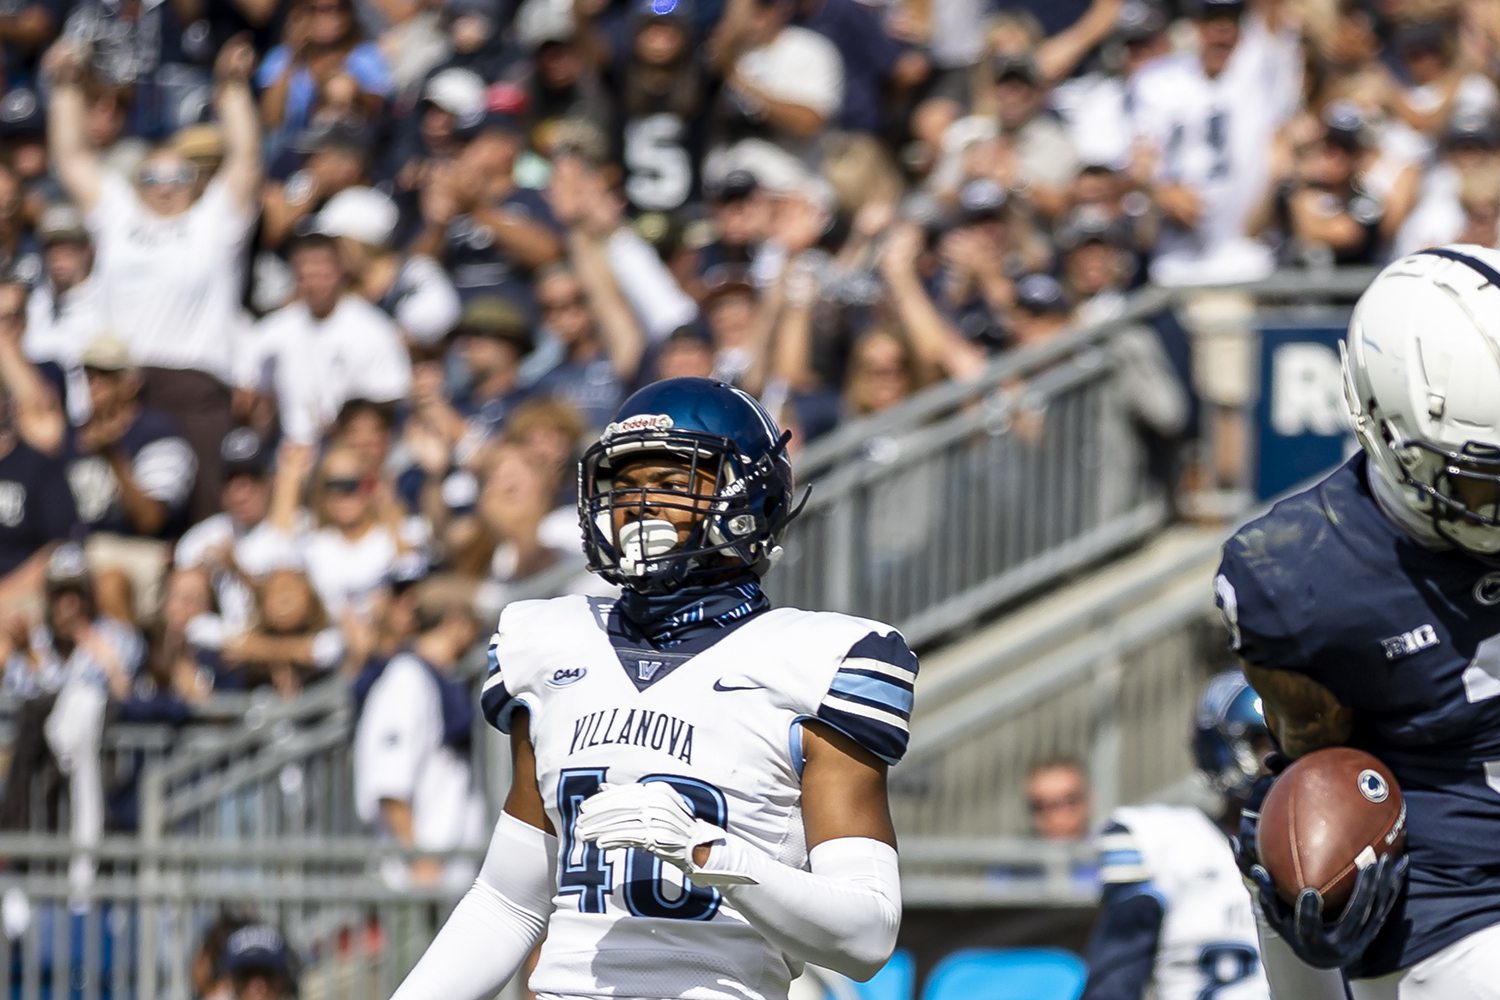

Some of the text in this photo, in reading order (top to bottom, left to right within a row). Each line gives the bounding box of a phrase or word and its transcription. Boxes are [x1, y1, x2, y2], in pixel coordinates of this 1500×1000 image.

[623, 113, 692, 210] 5
[553, 667, 581, 681] CAA
[568, 707, 695, 766] VILLANOVA
